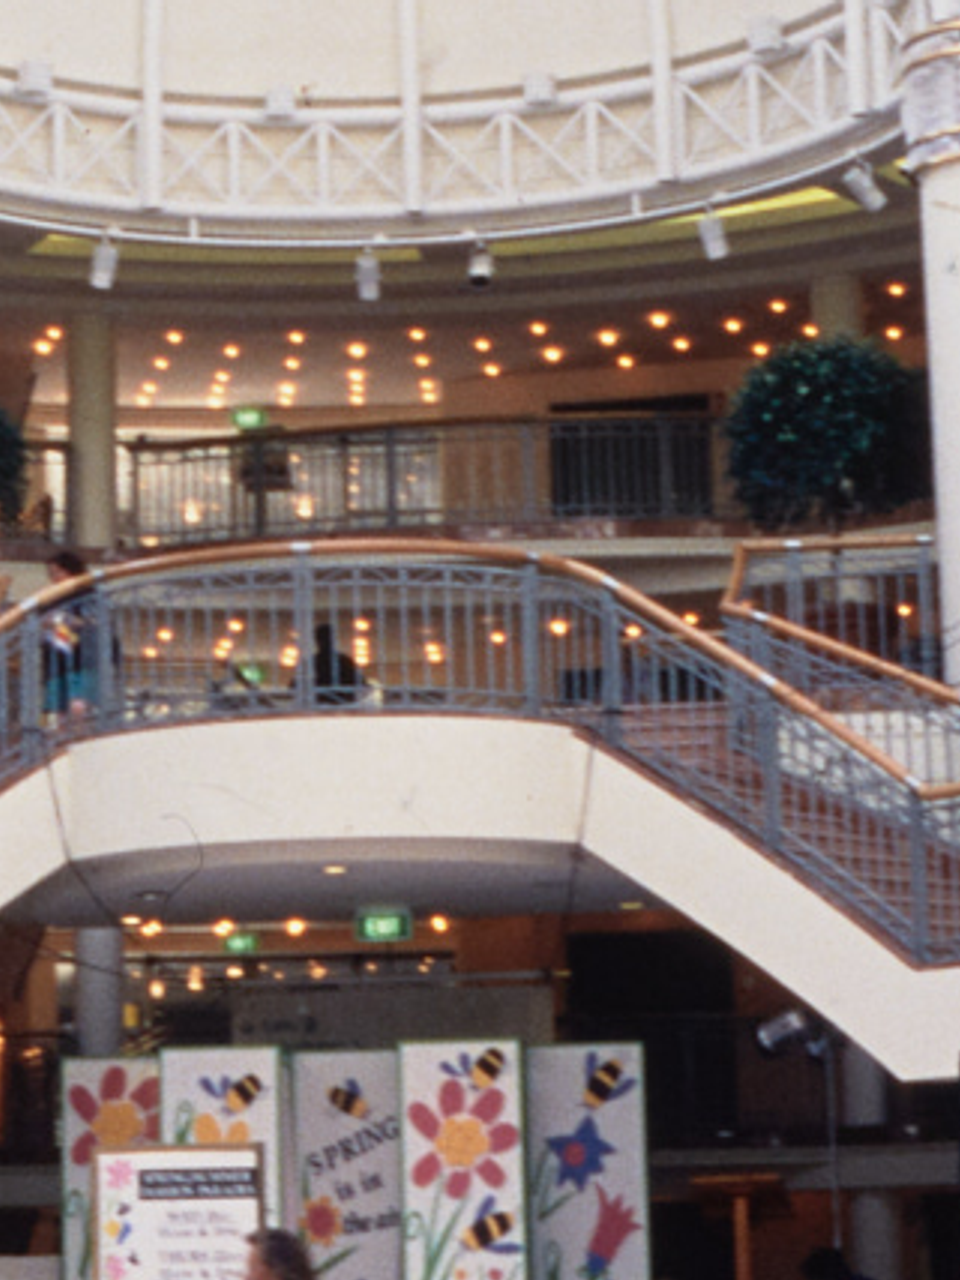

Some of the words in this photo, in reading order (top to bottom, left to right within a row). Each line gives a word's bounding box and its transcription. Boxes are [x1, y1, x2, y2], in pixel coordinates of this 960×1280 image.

[305, 1115, 400, 1176] SPRING
[334, 1182, 356, 1202] is
[359, 1170, 384, 1193] in
